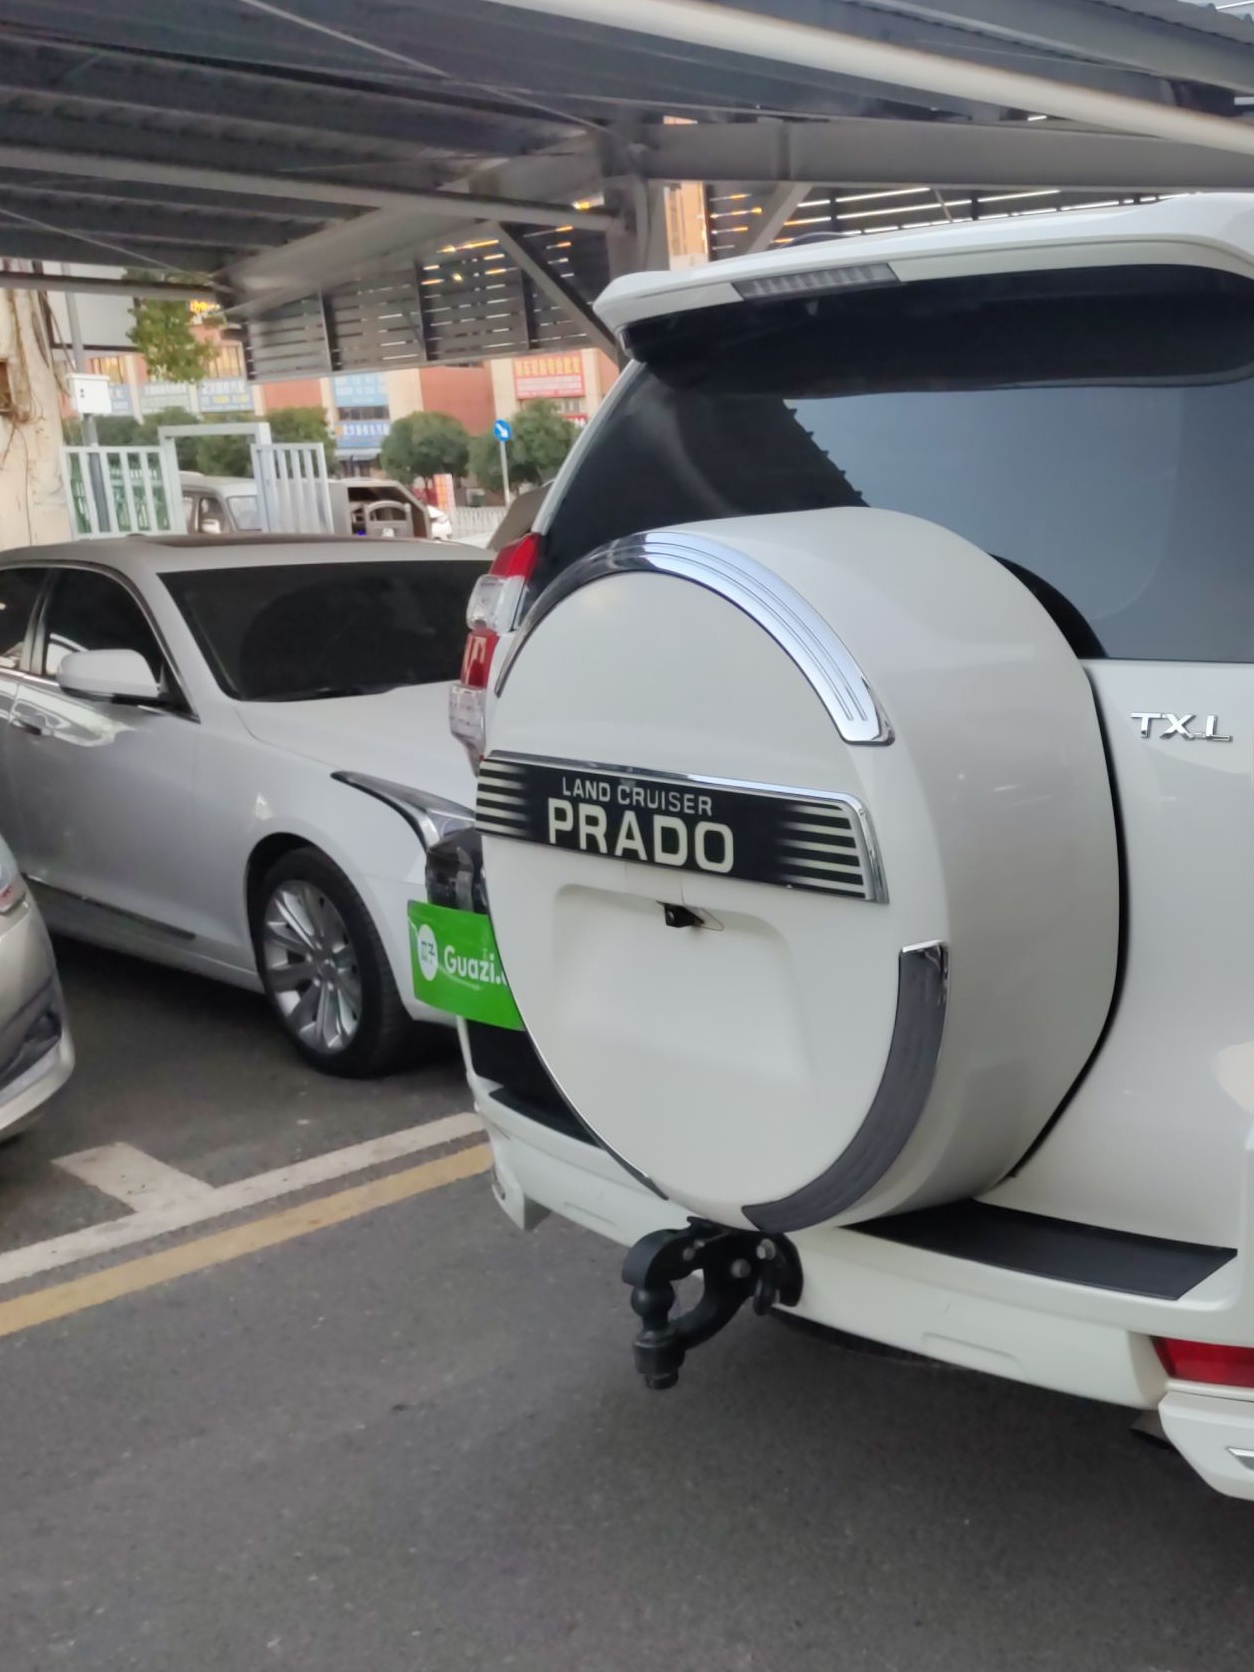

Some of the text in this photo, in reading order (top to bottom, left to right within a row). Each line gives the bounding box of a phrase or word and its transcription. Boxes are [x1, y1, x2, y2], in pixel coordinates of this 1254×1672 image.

[562, 777, 712, 817] LAND CRUISER
[548, 798, 734, 874] PRADO
[444, 945, 507, 986] Guazi.
